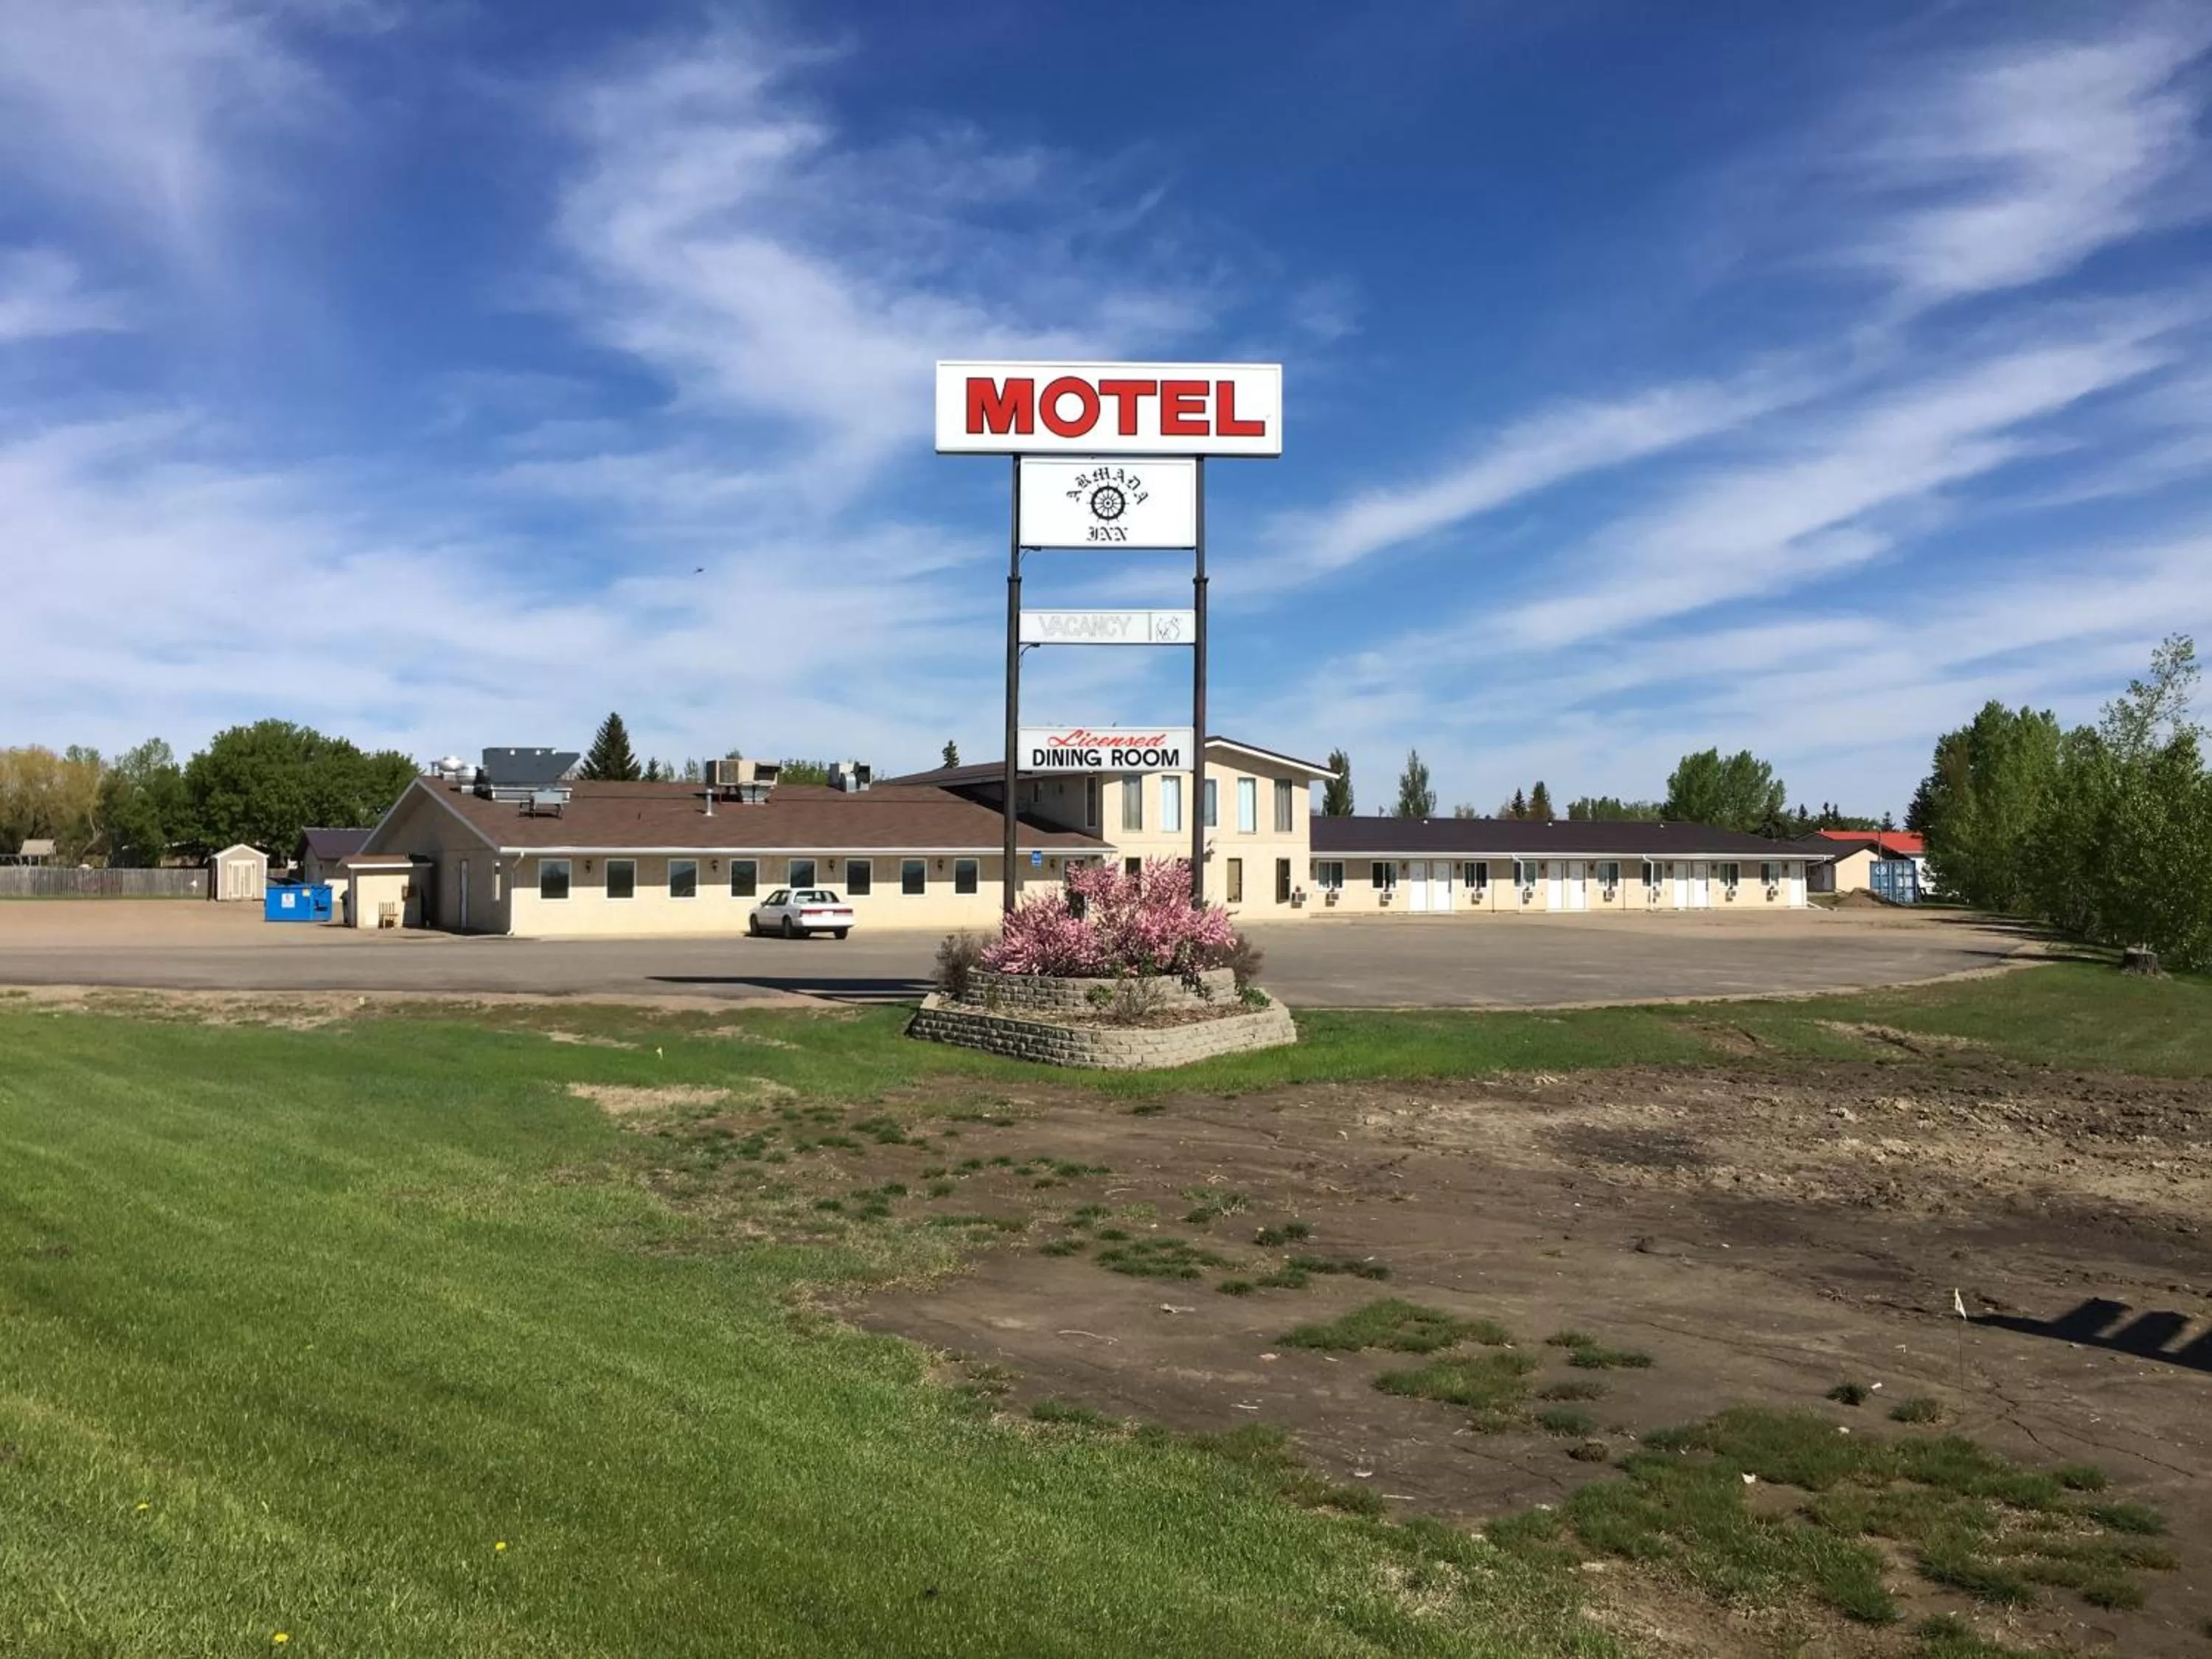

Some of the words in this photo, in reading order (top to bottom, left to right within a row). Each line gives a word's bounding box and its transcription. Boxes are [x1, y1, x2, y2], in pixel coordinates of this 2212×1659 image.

[966, 375, 1265, 438] MOTEL
[1066, 467, 1149, 505] ARMADA
[1085, 526, 1129, 542] INN
[1038, 615, 1132, 638] VACANCY
[1048, 729, 1166, 748] Licensed
[1032, 748, 1102, 767] DINING
[1111, 749, 1180, 767] ROOM
